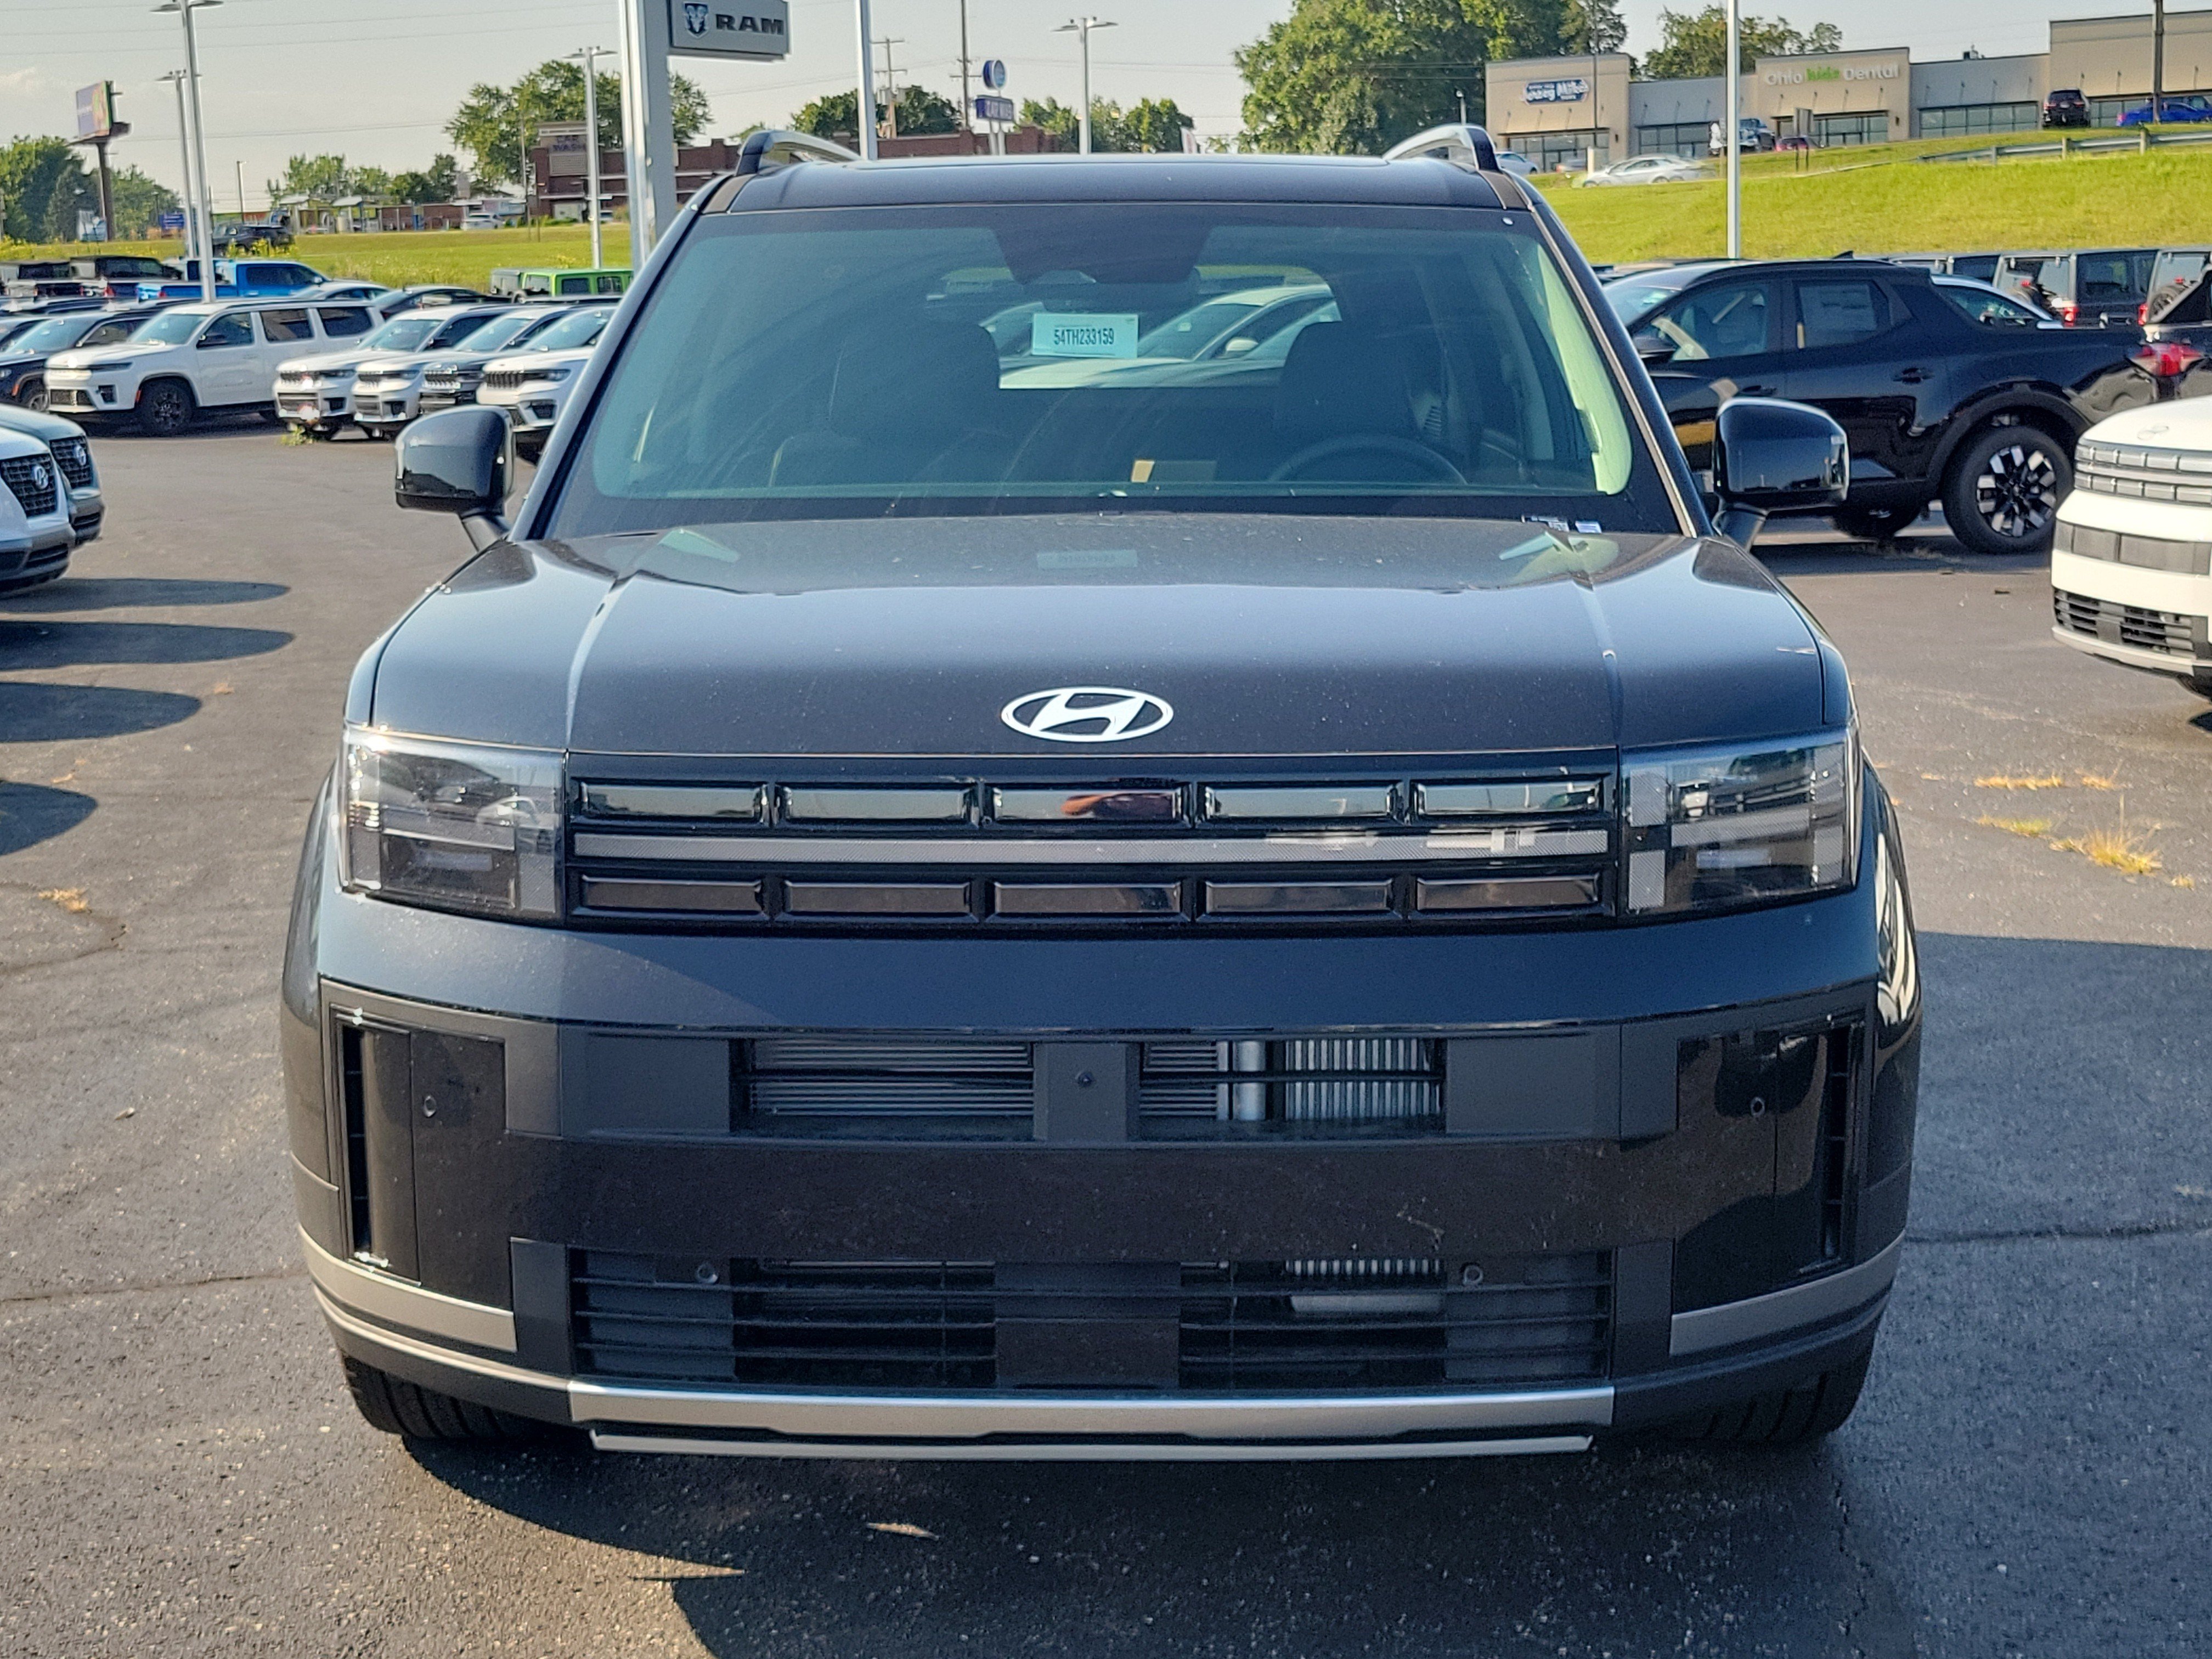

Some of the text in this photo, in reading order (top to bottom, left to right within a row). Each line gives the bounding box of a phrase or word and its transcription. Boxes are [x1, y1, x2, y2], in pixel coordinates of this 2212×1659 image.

[715, 14, 784, 35] RAM
[1766, 71, 1803, 85] Ohio
[1843, 64, 1899, 81] Dental
[1054, 328, 1114, 345] 54TH233159
